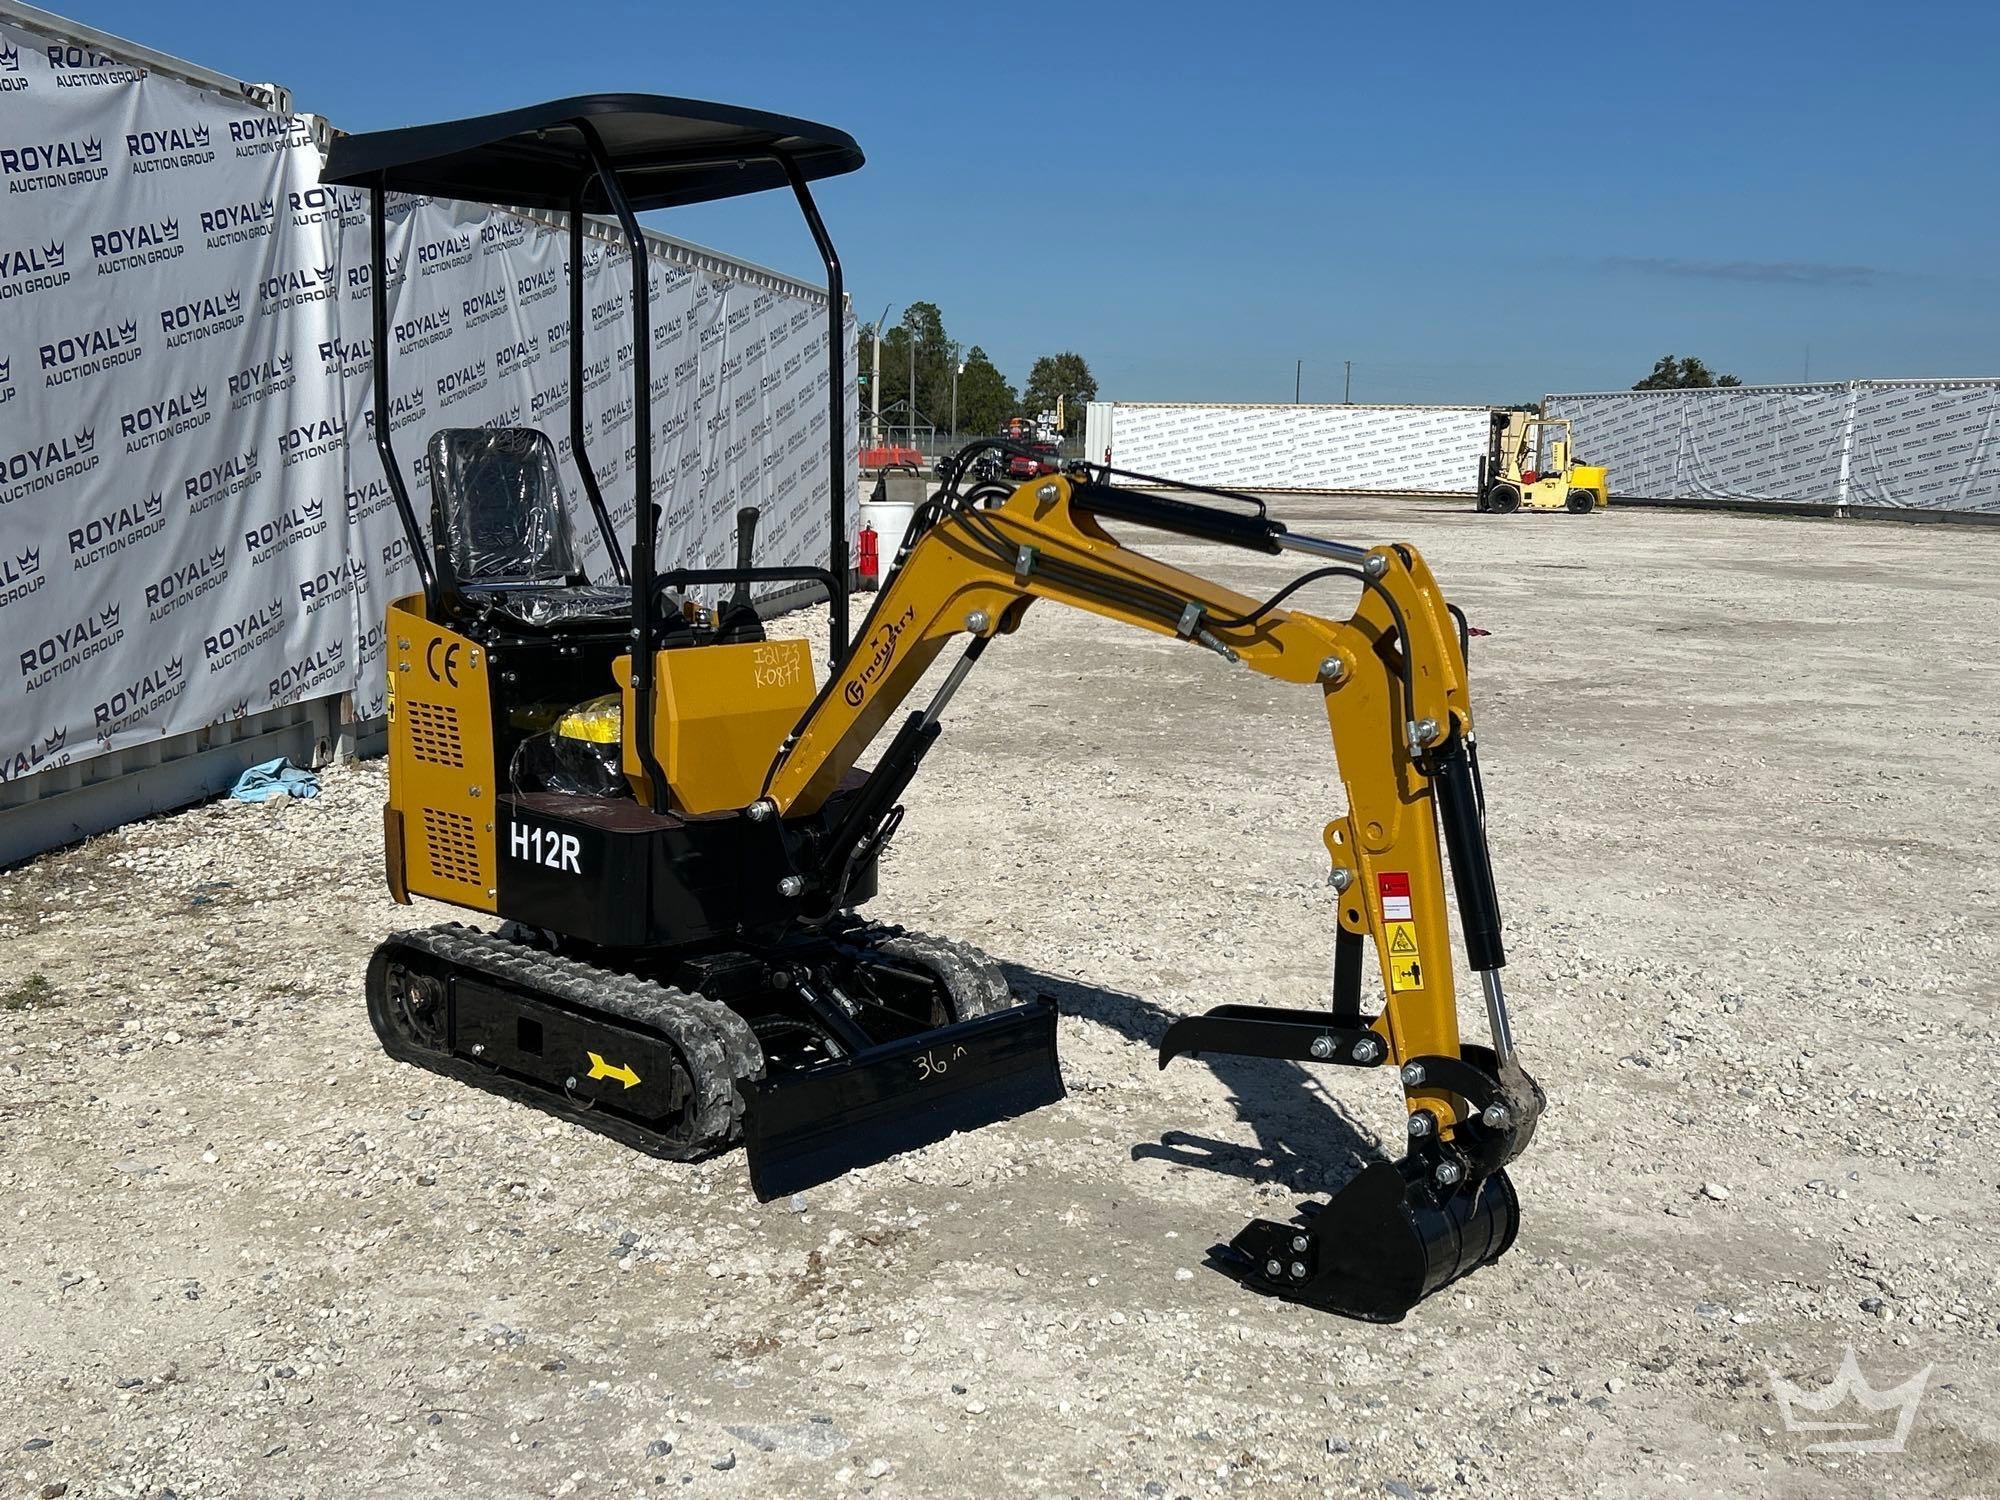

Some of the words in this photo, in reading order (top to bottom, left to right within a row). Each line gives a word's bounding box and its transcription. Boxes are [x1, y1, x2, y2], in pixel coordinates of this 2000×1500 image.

[56, 73, 109, 88] AUCTION
[229, 117, 287, 142] ROYAL
[126, 128, 195, 156] ROYAL
[235, 140, 274, 158] AUCTION
[1, 141, 86, 174] ROYAL
[132, 157, 179, 175] AUCTION
[180, 151, 215, 167] GROUP
[9, 173, 67, 194] AUCTION
[68, 167, 108, 185] GROUP
[201, 203, 261, 233] ROYAL
[340, 214, 366, 228] GROUP
[90, 223, 163, 258] ROYAL
[206, 229, 247, 249] AUCTION
[480, 221, 515, 244] ROYAL
[97, 254, 146, 276] AUCTION
[148, 245, 184, 263] GROUP
[418, 238, 462, 263] ROYAL
[421, 262, 451, 277] AUCTION
[451, 254, 473, 268] GROUP
[665, 267, 685, 284] ROYAL
[25, 272, 71, 292] GROUP
[259, 270, 316, 301] ROYAL
[517, 273, 549, 296] ROYAL
[260, 297, 295, 317] AUCTION
[295, 286, 337, 304] GROUP
[462, 290, 498, 317] ROYAL
[519, 294, 542, 307] AUCTION
[541, 285, 558, 297] GROUP
[753, 294, 769, 309] ROYAL
[161, 295, 226, 332] ROYAL
[465, 313, 490, 329] AUCTION
[490, 305, 508, 320] GROUP
[591, 299, 617, 321] ROYAL
[728, 308, 745, 326] ROYAL
[791, 312, 805, 326] ROYAL
[166, 325, 210, 349] AUCTION
[212, 315, 244, 334] GROUP
[395, 312, 440, 343] ROYAL
[547, 320, 570, 343] ROYA
[654, 319, 676, 341] ROYAL
[700, 325, 719, 344] ROYAL
[770, 325, 784, 341] ROYAL
[39, 327, 120, 369] ROYAL
[399, 339, 429, 357] AUCTION
[429, 327, 453, 344] GROUP
[746, 341, 761, 357] ROYAL
[45, 363, 100, 388] AUCTION
[102, 347, 142, 369] GROUP
[228, 359, 281, 397] ROYAL
[498, 363, 522, 379] AUCTION
[674, 358, 693, 379] ROYAL
[437, 366, 477, 395] ROYAL
[760, 372, 778, 389] ROYAL
[231, 387, 267, 412] AUCTION
[267, 375, 296, 396] GROUP
[440, 391, 467, 408] AUCTION
[467, 378, 488, 395] GROUP
[531, 384, 562, 412] ROYAL
[735, 391, 752, 410] ROYAL
[1803, 398, 1820, 406] ROYAL
[1885, 397, 1904, 406] ROYAL
[1931, 400, 1951, 408] ROYAL
[1961, 391, 1982, 400] ROYAL
[120, 394, 192, 437] ROYAL
[401, 408, 426, 426] GROUP
[532, 404, 554, 423] AUCTION
[601, 400, 626, 426] ROYAL
[776, 402, 792, 419] ROYAL
[1818, 408, 1835, 416] ROYAL
[1873, 416, 1891, 424] ROYAL
[1901, 408, 1921, 417] ROYAL
[1945, 412, 1967, 421] ROYAL
[126, 427, 174, 454] AUCTION
[175, 412, 211, 434] GROUP
[278, 416, 344, 455] ROYAL
[662, 412, 684, 436] ROYAL
[1887, 428, 1906, 436] ROYAL
[1915, 420, 1936, 428] ROYAL
[1963, 423, 1984, 432] ROYAL
[1902, 439, 1923, 447] ROYAL
[1932, 432, 1952, 440] ROYAL
[681, 447, 700, 469] ROYAL
[725, 442, 743, 460] ROYAL
[763, 450, 780, 468] ROYAL
[1793, 444, 1809, 452] ROYAL
[1917, 451, 1936, 459] ROYAL
[1947, 444, 1967, 452] ROYAL
[1964, 455, 1985, 464] ROYAL
[56, 455, 99, 482] GROUP
[184, 456, 246, 500] ROYAL
[1904, 470, 1923, 478] ROYAL
[1934, 463, 1953, 471] ROYAL
[189, 487, 230, 516] AUCTION
[230, 471, 262, 497] GROUP
[1966, 487, 1986, 495] ROYAL
[668, 503, 689, 528] ROYAL
[711, 493, 730, 516] ROYAL
[68, 503, 145, 553] ROYAL
[245, 509, 305, 552] ROYAL
[768, 525, 783, 544] ROYAL
[73, 537, 126, 571] AUCTION
[127, 518, 166, 545] GROUP
[251, 537, 289, 567] AUCTION
[290, 520, 327, 545] GROUP
[144, 558, 210, 607] ROYAL
[149, 590, 194, 624] AUCTION
[195, 570, 228, 596] GROUP
[306, 586, 348, 615] AUCTION
[203, 609, 270, 659] ROYAL
[20, 617, 101, 676] ROYAL
[210, 638, 255, 674] AUCTION
[256, 619, 285, 647] GROUP
[25, 655, 80, 694] AUCTION
[82, 629, 124, 660] GROUP
[426, 637, 460, 688] CE
[269, 651, 328, 700] ROYAL
[311, 660, 346, 687] GROUP
[93, 670, 167, 727] ROYAL
[97, 702, 149, 743] AUCTION
[150, 680, 187, 711] GROUP
[510, 821, 581, 875] H12R
[912, 1050, 947, 1080] 36
[952, 1043, 967, 1060] in
